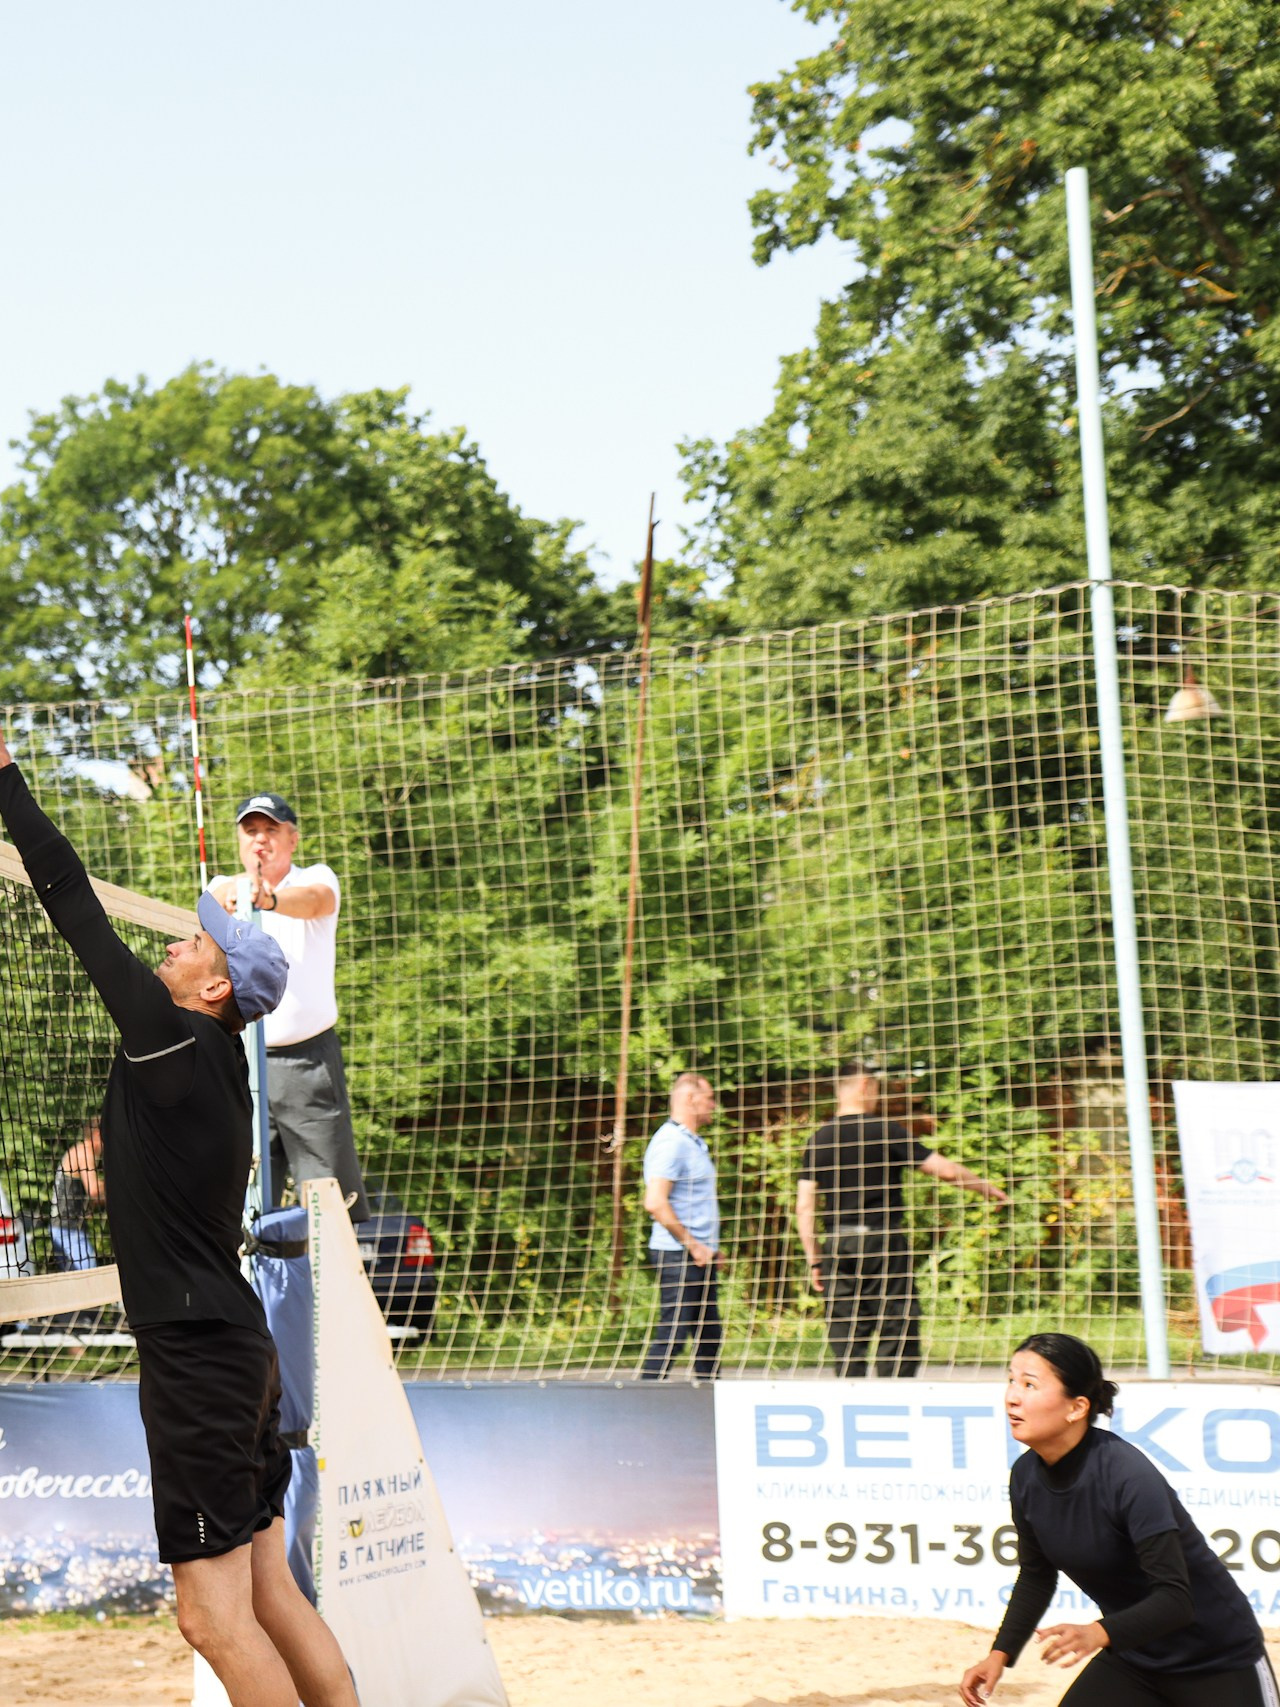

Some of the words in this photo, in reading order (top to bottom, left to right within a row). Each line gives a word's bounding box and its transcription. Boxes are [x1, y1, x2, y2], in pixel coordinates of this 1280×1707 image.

[756, 1482, 850, 1499] КЛИНИКА
[856, 1482, 993, 1502] НЕОТЛОЖНОЙ
[339, 1550, 348, 1571] В
[355, 1531, 425, 1567] ГАТЧИНЕ
[521, 1568, 692, 1608] vetiko.ru
[761, 1579, 920, 1612] Гатчина,
[931, 1586, 986, 1612] ул.
